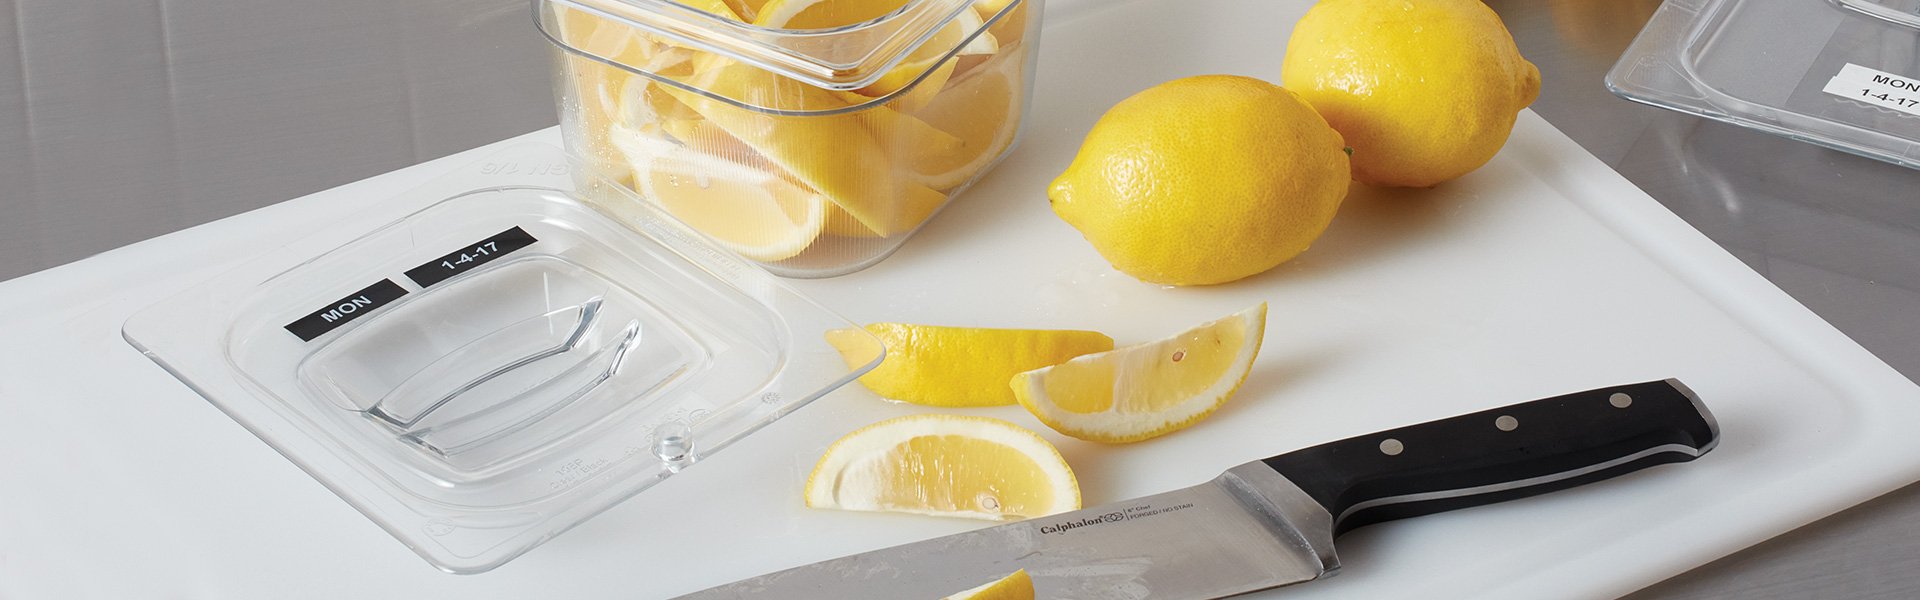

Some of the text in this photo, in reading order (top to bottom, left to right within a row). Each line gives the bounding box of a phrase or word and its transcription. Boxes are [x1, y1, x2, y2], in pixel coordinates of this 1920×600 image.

[1872, 74, 1920, 92] MON
[1861, 88, 1920, 108] 1-4-17
[441, 241, 498, 270] 1-4-17
[321, 295, 372, 322] MON
[1040, 516, 1103, 534] Calphalon
